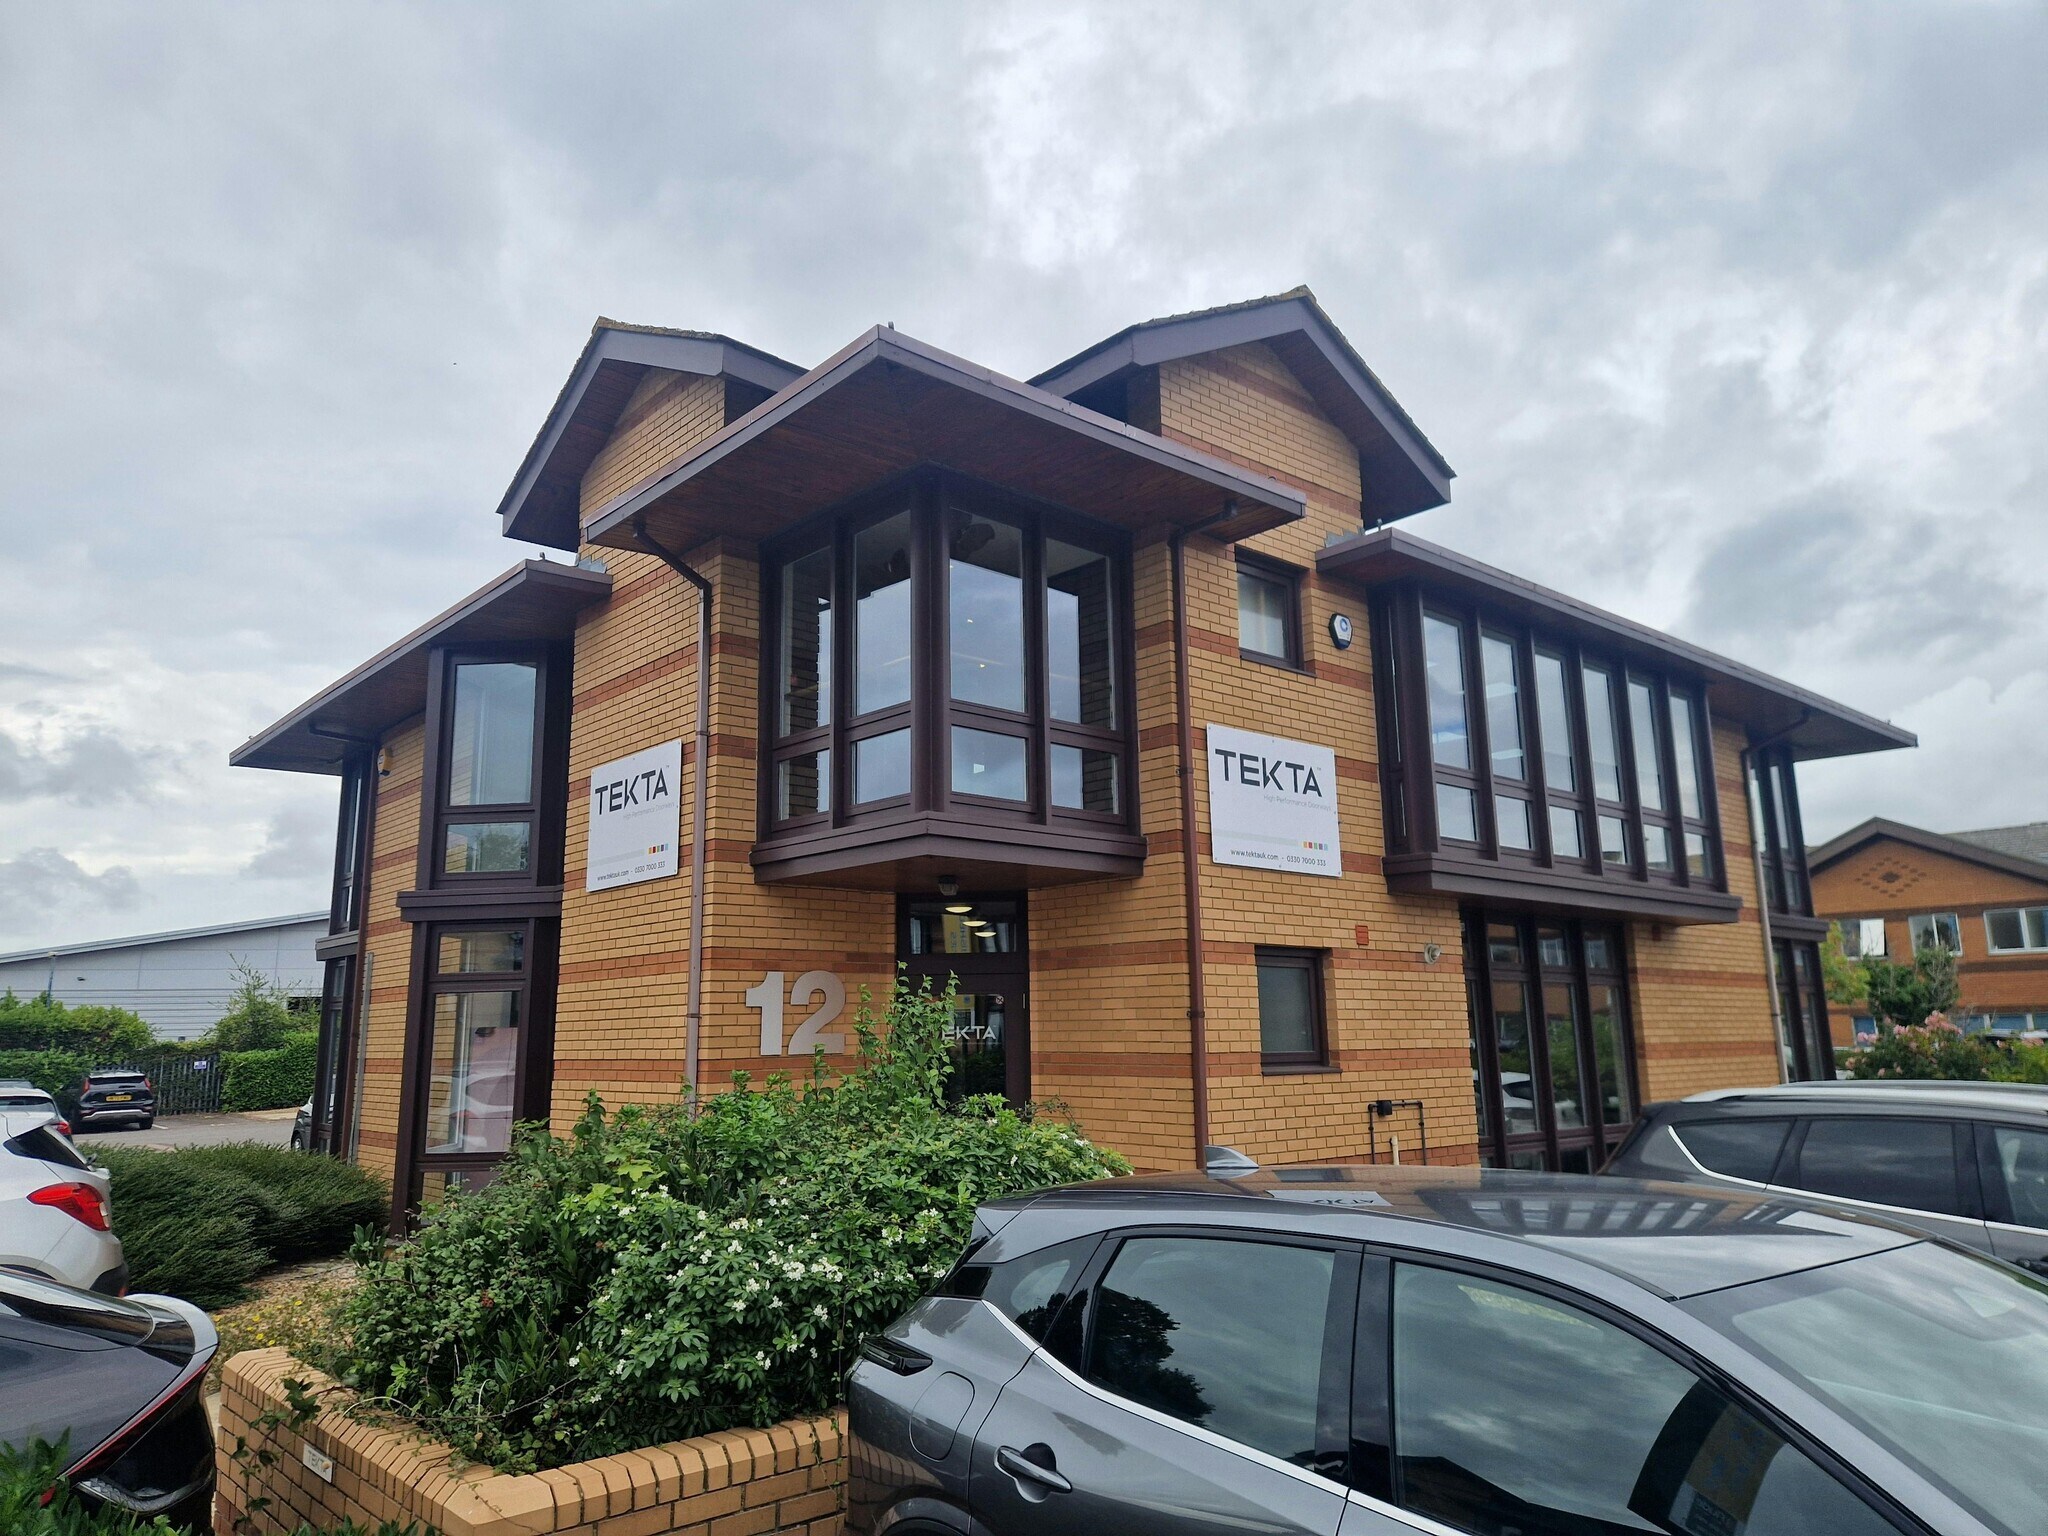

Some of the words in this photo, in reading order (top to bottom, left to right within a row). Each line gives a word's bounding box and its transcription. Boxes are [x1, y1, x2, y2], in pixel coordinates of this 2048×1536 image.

[595, 767, 669, 815] TEKTA
[1215, 749, 1322, 797] TEKTA
[1230, 849, 1279, 861] www.tektauk.com
[1286, 855, 1301, 864] 0330
[1302, 856, 1316, 865] 7000
[1316, 858, 1326, 867] 333
[745, 970, 846, 1056] 12
[941, 1025, 997, 1041] EKTA
